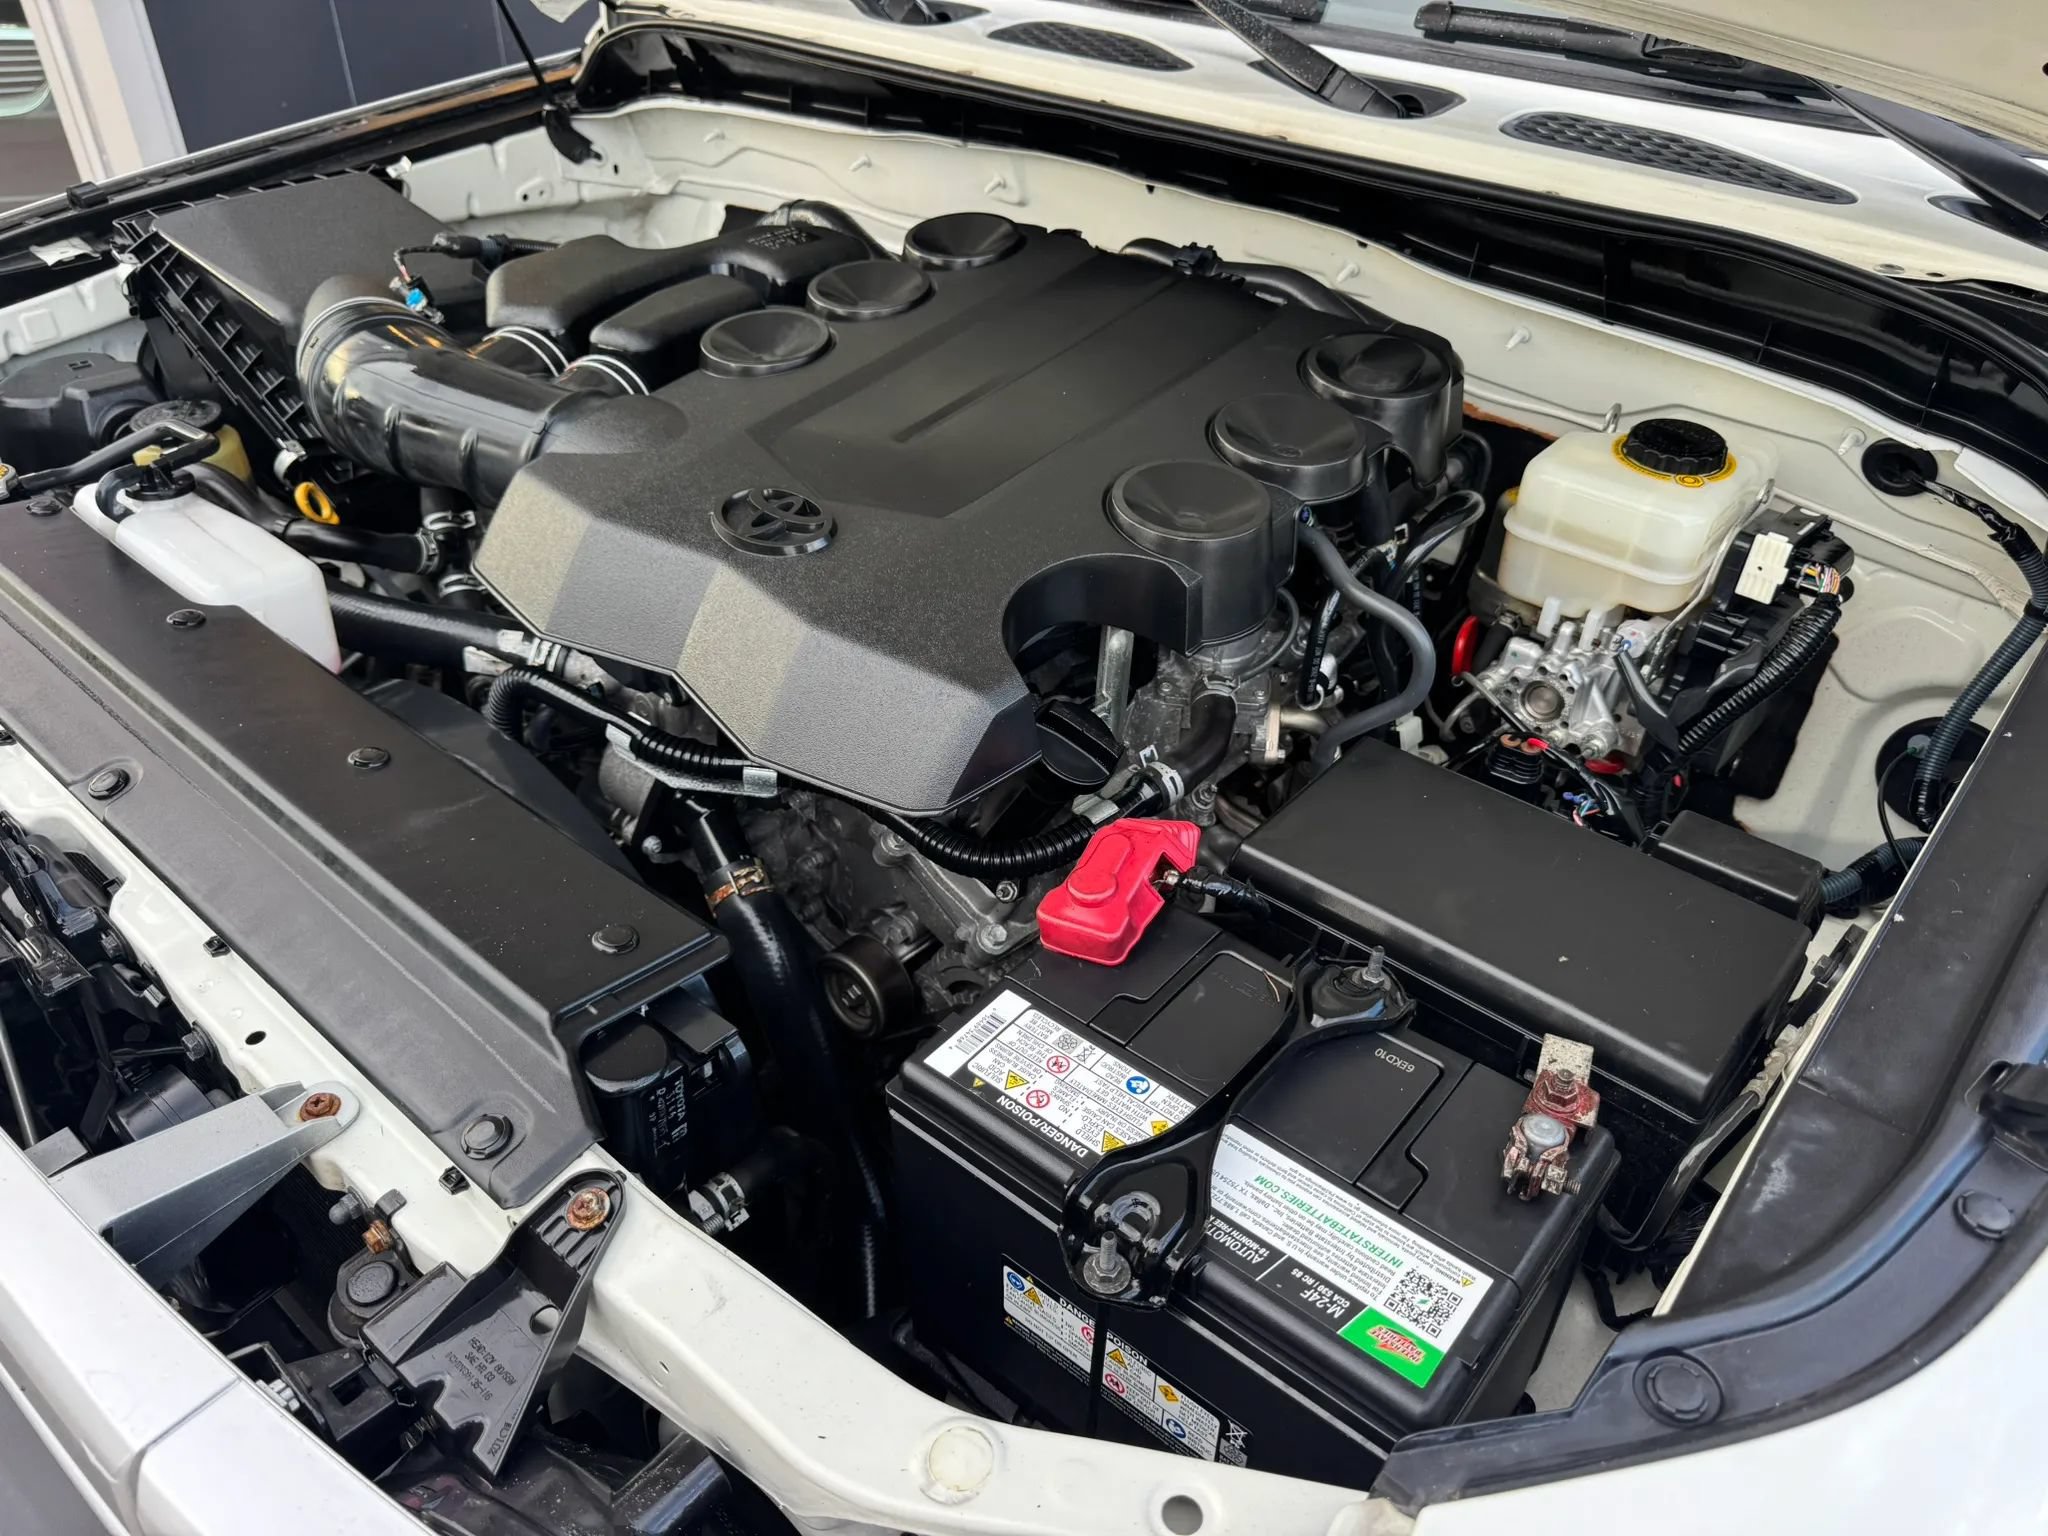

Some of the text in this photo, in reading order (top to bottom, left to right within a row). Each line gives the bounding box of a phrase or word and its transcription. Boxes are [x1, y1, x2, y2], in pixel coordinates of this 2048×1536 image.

[1021, 1021, 1049, 1040] BATTERY
[1027, 1017, 1054, 1035] MUST BE
[986, 1046, 1037, 1079] CAUSE BLINDNESS
[986, 1063, 1006, 1076] ACID
[991, 1057, 1006, 1068] CAN
[1374, 1048, 1415, 1072] 6EKD10
[970, 1061, 1004, 1084] SULFURIC
[1103, 1071, 1123, 1085] READ
[1047, 1090, 1072, 1106] SPARKS
[1051, 1084, 1077, 1102] FLAMES
[1095, 1086, 1110, 1097] GET
[1107, 1085, 1127, 1099] HELP
[1056, 1103, 1071, 1114] NO
[1067, 1077, 1144, 1126] FLUSH EYES IMMEDIATELY
[1123, 1096, 1154, 1116] MEDICAL
[1080, 1106, 1103, 1121] CAUSE
[1129, 1107, 1149, 1121] WITH
[993, 1094, 1090, 1158] DANGER/POISON
[1100, 1118, 1116, 1129] CAN
[1073, 1127, 1102, 1147] SHIELD
[1238, 1186, 1249, 1195] TX
[1238, 1210, 1251, 1220] call
[1253, 1172, 1404, 1269] INTERSTATEBATTERIES.COM
[1212, 1217, 1233, 1233] FREE
[1228, 1228, 1270, 1257] 18-MONTH
[1272, 1231, 1285, 1242] and
[1299, 1232, 1331, 1255] authorized
[1313, 1232, 1346, 1255] Interstate
[1303, 1249, 1331, 1270] warranty
[1330, 1251, 1358, 1271] Batteries
[1344, 1250, 1356, 1261] by
[1328, 1266, 1347, 1281] under
[1353, 1257, 1391, 1283] Distributed
[1356, 1268, 1386, 1289] Interstate
[1290, 1267, 1351, 1308] CCA 530 RC 85
[1345, 1276, 1370, 1295] replace
[1297, 1284, 1346, 1320] M-24F
[1367, 1291, 1379, 1301] To
[1059, 1296, 1094, 1329] DANGE
[1106, 1330, 1147, 1367] POISON
[1368, 1328, 1421, 1364] INTERSTATE
[1376, 1325, 1423, 1357] BATTERIES
